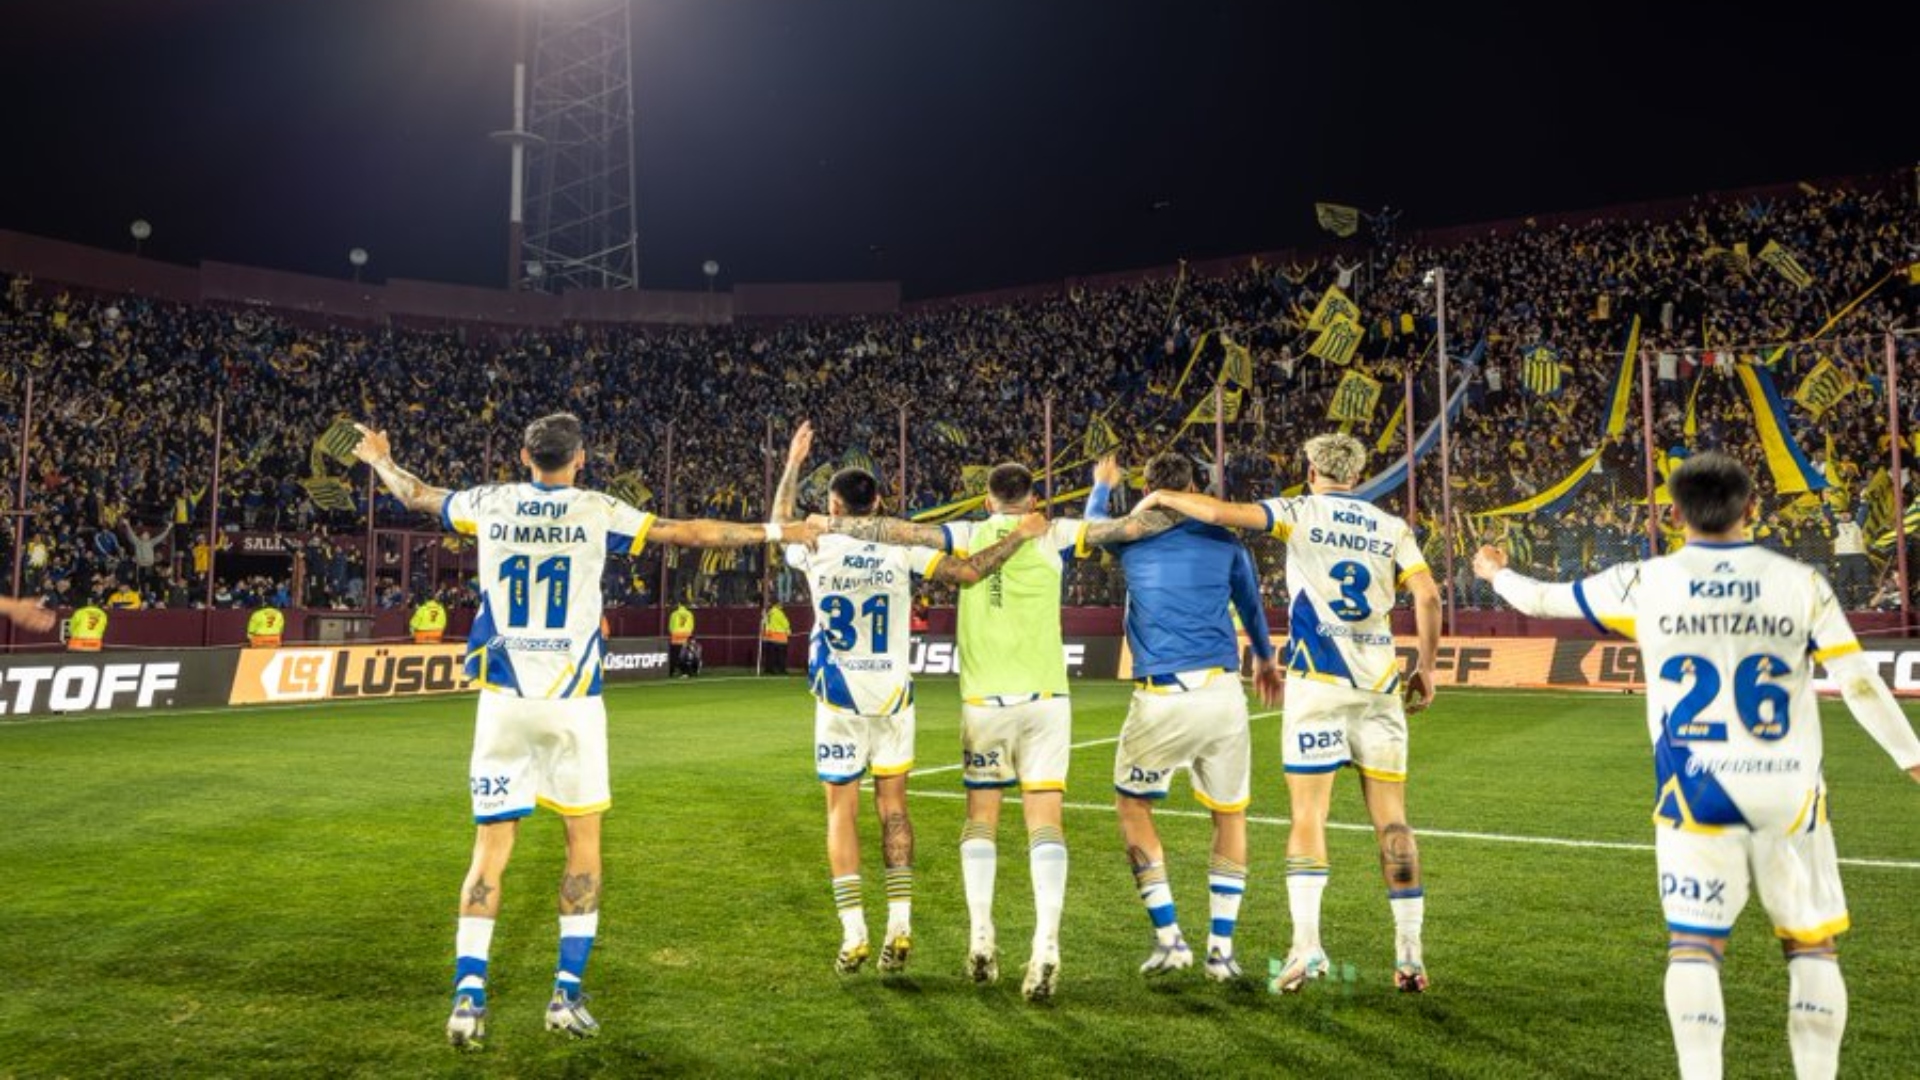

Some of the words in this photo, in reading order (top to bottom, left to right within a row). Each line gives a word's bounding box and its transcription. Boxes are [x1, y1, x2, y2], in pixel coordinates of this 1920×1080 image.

[490, 523, 508, 541] DI
[513, 526, 587, 543] MARIA
[1309, 527, 1394, 558] SANDEZ
[499, 555, 571, 628] 11
[1328, 560, 1372, 622] 3
[820, 593, 890, 653] 31
[1658, 614, 1795, 637] CANTIZANO
[0, 662, 181, 714] TOFF
[1659, 653, 1792, 742] 26
[818, 743, 856, 762] pax
[1298, 729, 1344, 752] pax
